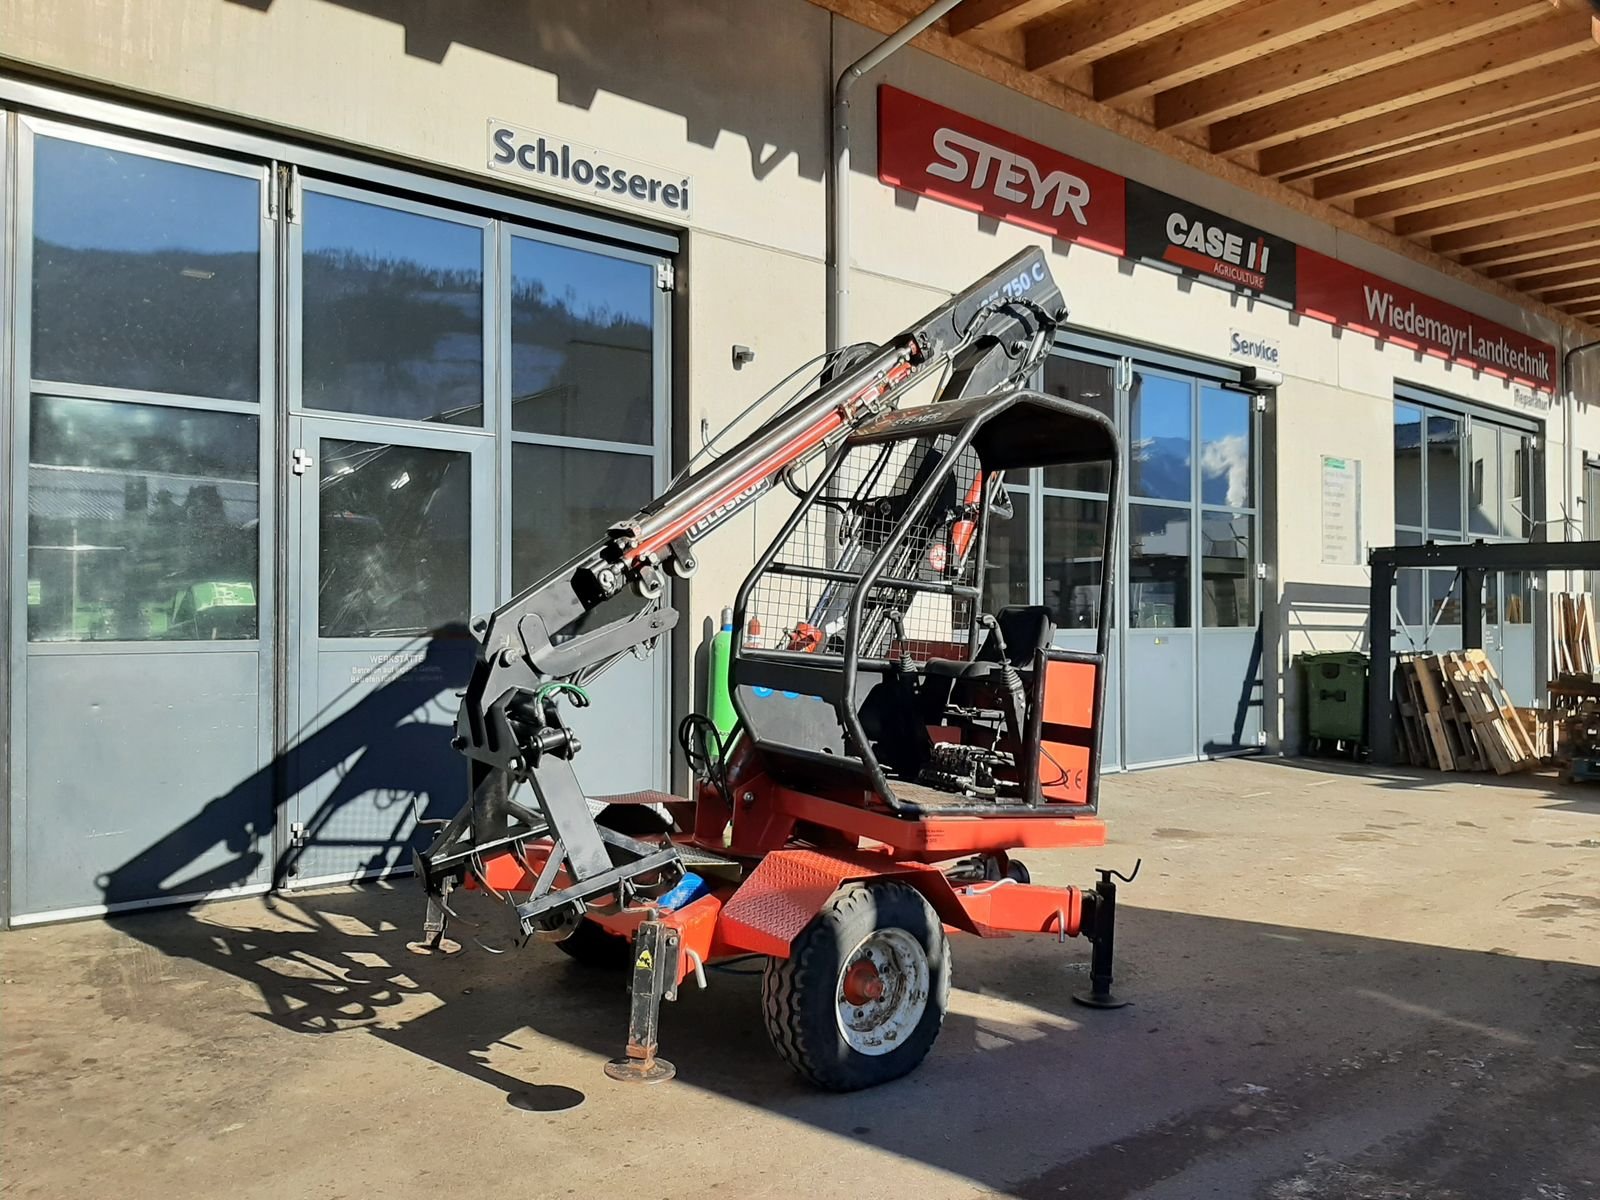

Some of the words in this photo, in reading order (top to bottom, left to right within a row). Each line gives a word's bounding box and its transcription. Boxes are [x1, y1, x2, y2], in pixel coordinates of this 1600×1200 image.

[493, 128, 689, 210] Schlosserei
[925, 127, 1091, 226] STEYR
[1166, 212, 1243, 265] CASE
[1002, 273, 1031, 298] 750
[1032, 262, 1045, 281] C
[1213, 262, 1265, 289] AGRICULTURE
[1231, 332, 1279, 363] Service
[1363, 285, 1467, 357] Wiedemayr
[1468, 325, 1550, 381] Landtechnik
